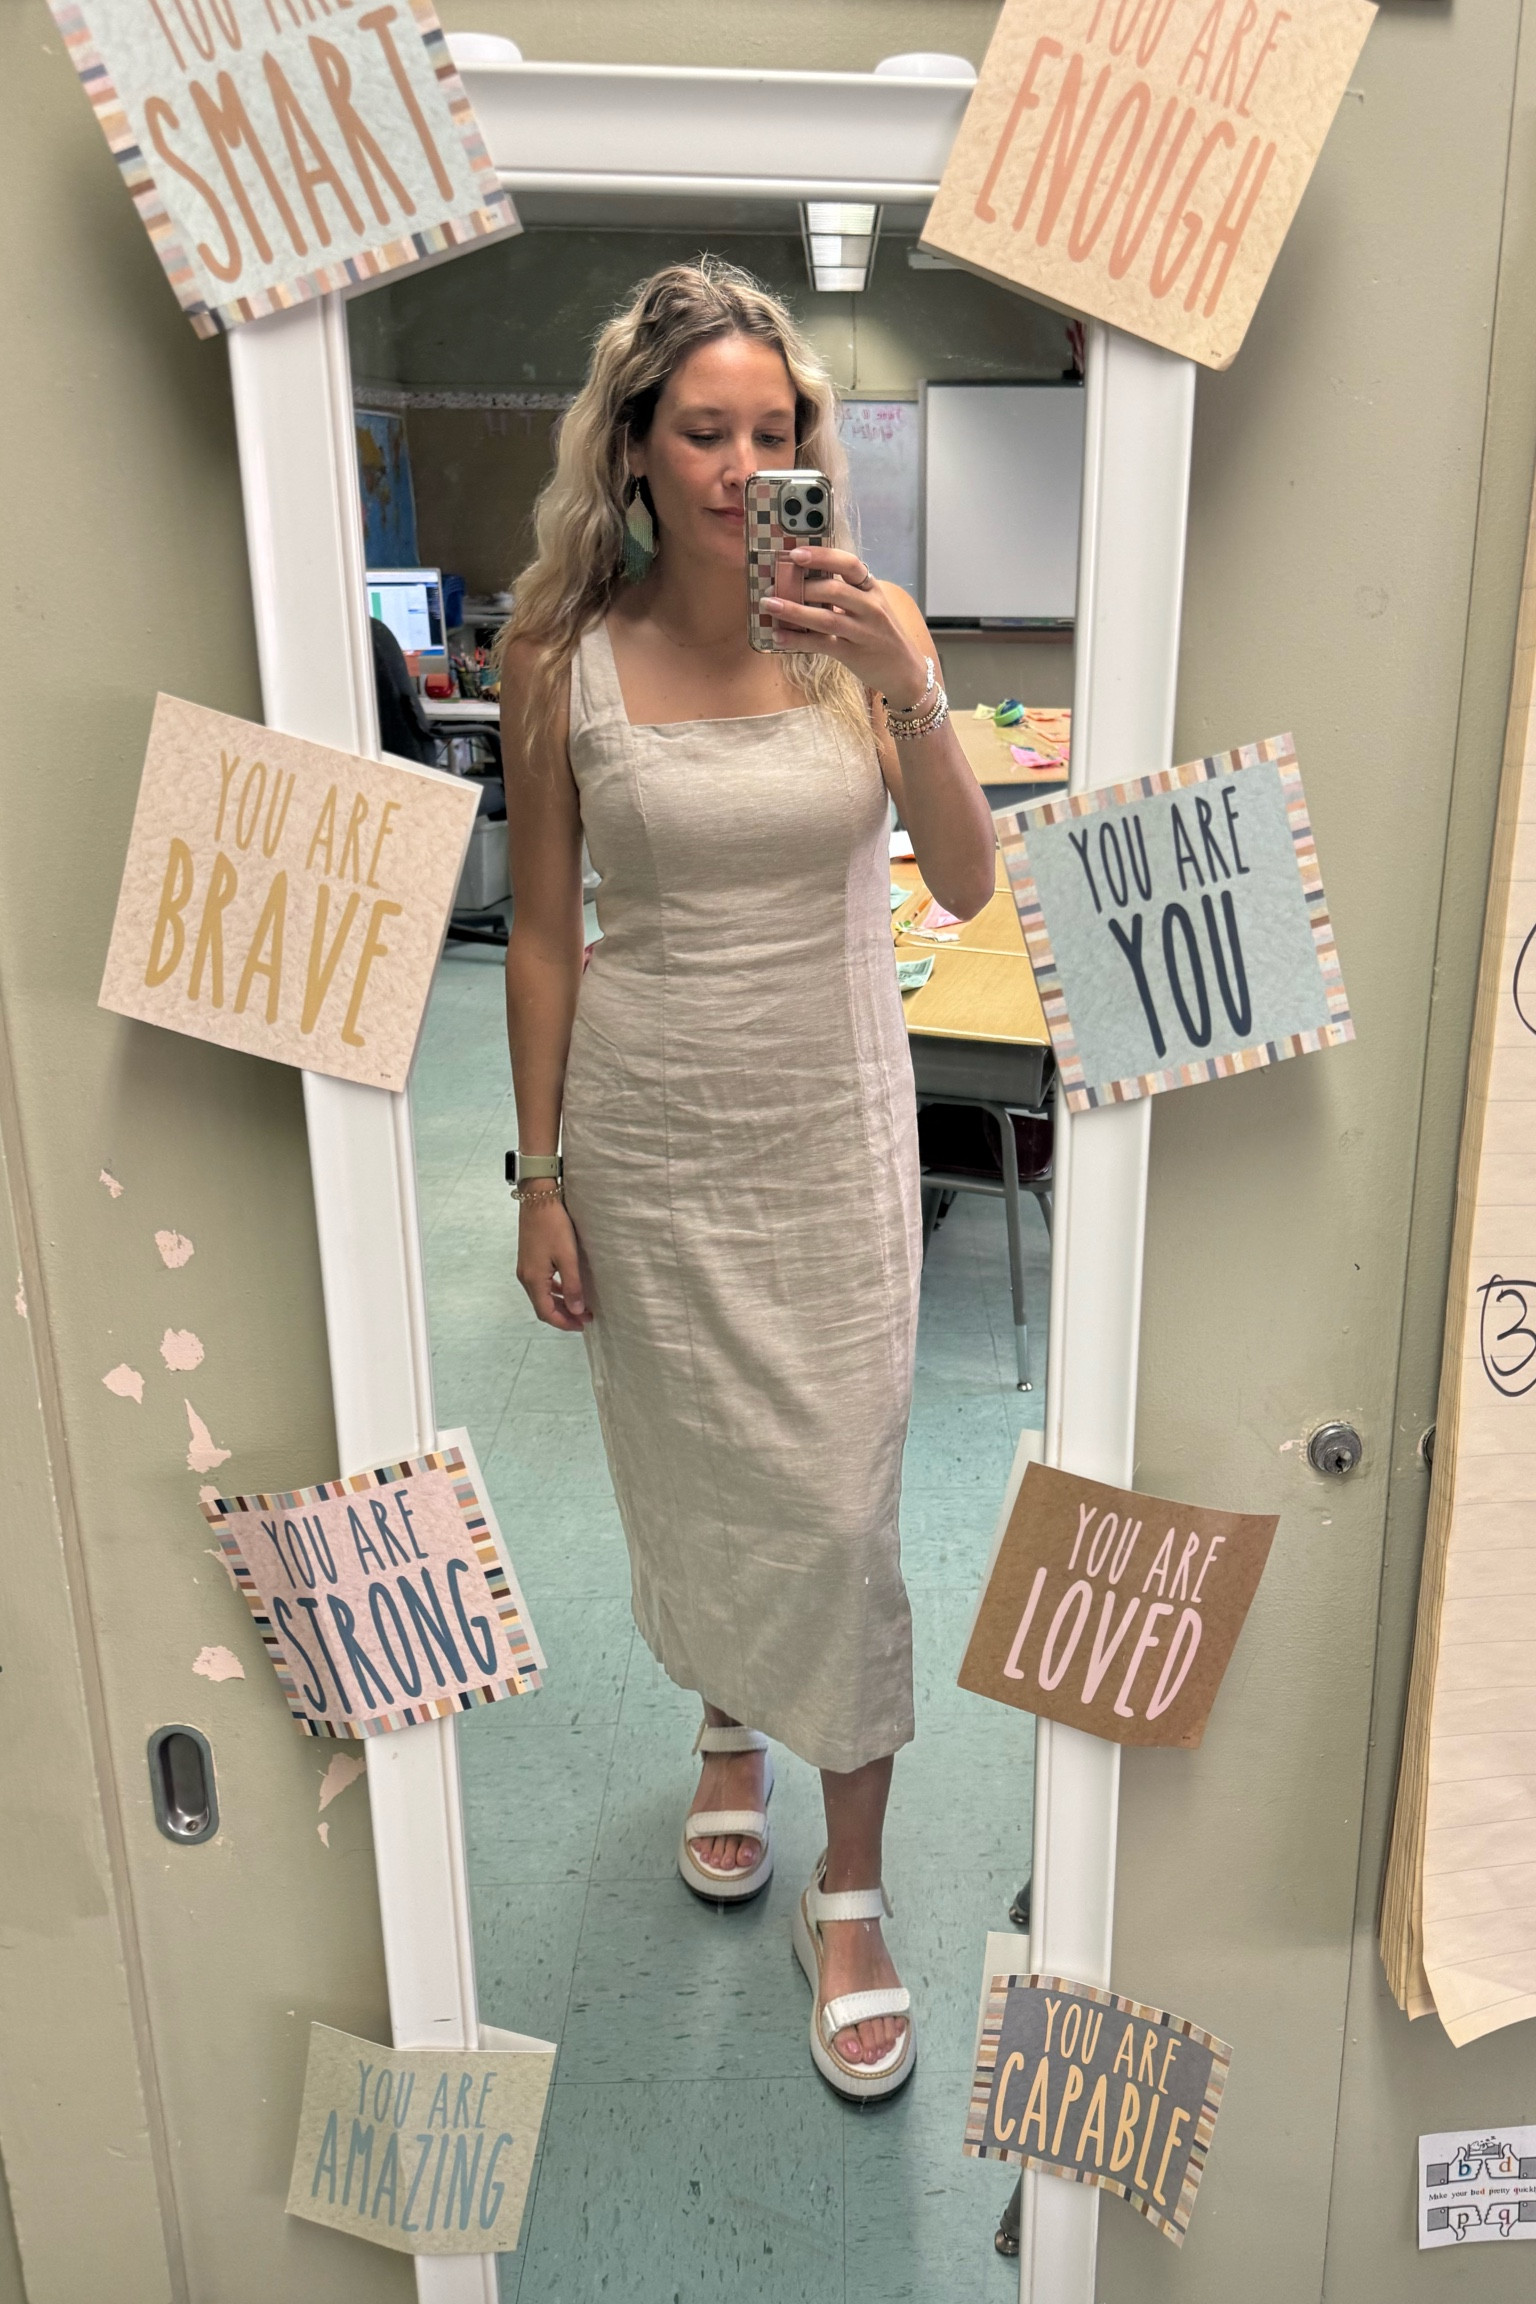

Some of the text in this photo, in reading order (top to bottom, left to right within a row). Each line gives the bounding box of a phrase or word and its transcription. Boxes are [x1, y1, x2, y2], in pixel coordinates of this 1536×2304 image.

[1177, 0, 1292, 118] ARE
[144, 4, 455, 283] SMART
[973, 36, 1277, 318] ENOUGH
[214, 749, 402, 889] YOU ARE
[1068, 786, 1250, 914] YOU ARE
[144, 837, 403, 1047] BRAVE
[1108, 890, 1252, 1058] YOU
[1489, 1288, 1536, 1377] 3
[261, 1489, 429, 1590] YOU ARE
[1068, 1502, 1226, 1603] YOU ARE
[272, 1558, 498, 1715] STRONG
[1003, 1566, 1202, 1721] LOVED
[358, 2059, 498, 2130] YOU ARE
[1044, 1997, 1182, 2095] YOU ARE
[311, 2109, 514, 2232] AMAZING
[994, 2051, 1191, 2206] CAPABLE
[1458, 2156, 1511, 2177] b d
[1428, 2193, 1448, 2201] Make
[1451, 2191, 1467, 2199] your
[1470, 2188, 1486, 2196] bed
[1488, 2187, 1510, 2196] pretty
[1457, 2208, 1510, 2229] p q
